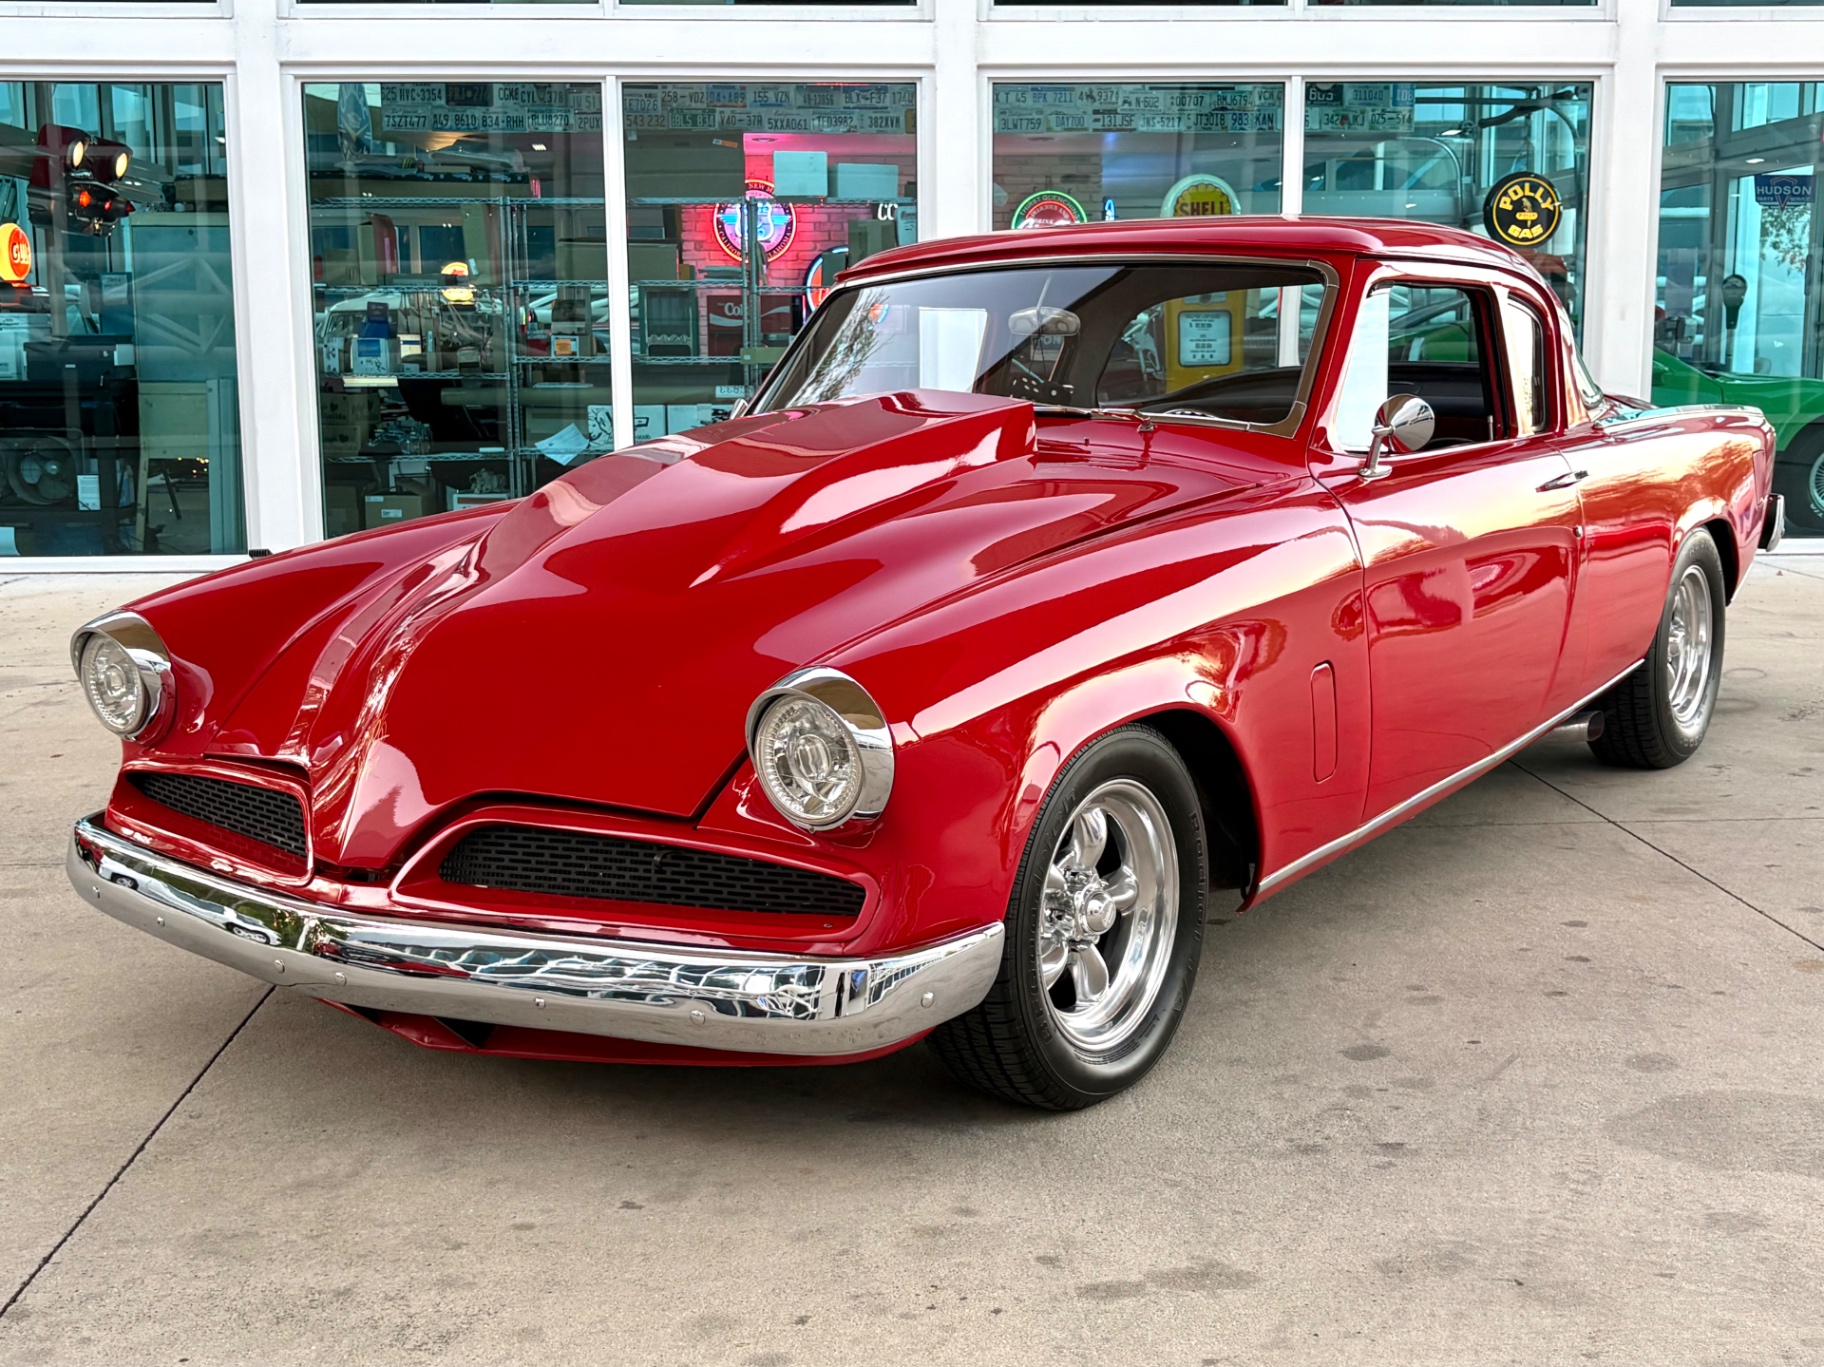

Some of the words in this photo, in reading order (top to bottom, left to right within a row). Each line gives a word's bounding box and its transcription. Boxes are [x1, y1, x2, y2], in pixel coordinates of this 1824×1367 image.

[1499, 182, 1555, 212] POLLY
[1756, 185, 1812, 195] HUDSON
[1508, 224, 1544, 239] GAS
